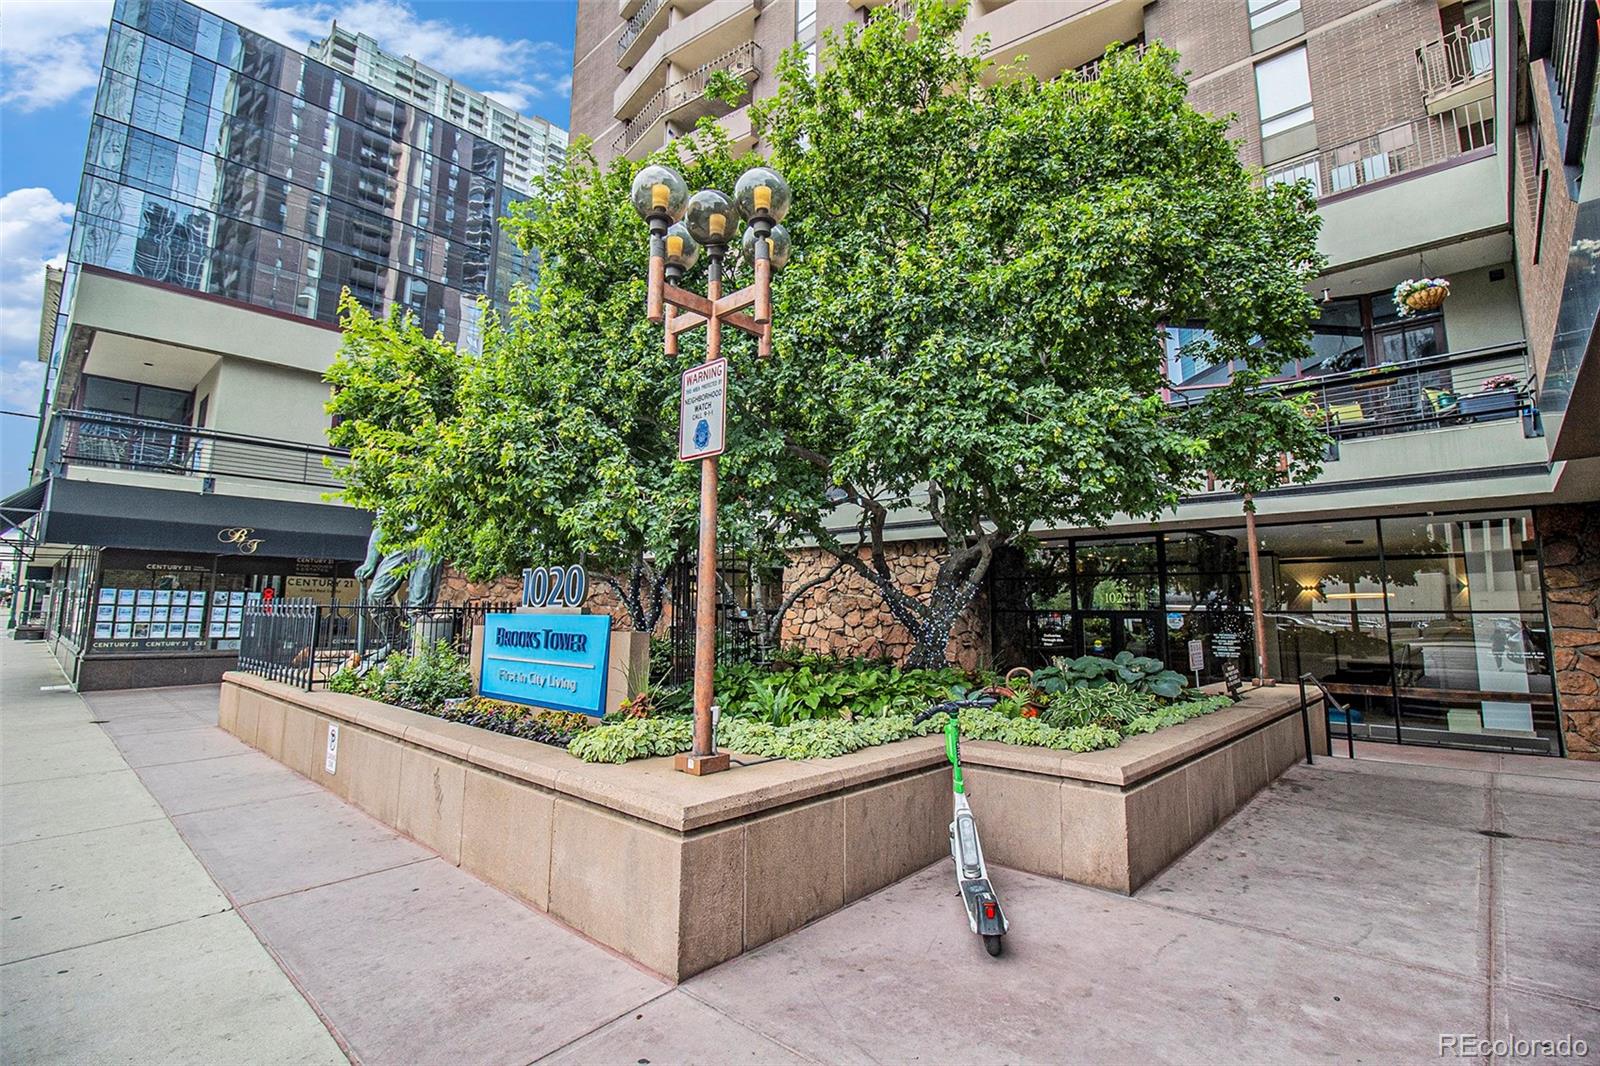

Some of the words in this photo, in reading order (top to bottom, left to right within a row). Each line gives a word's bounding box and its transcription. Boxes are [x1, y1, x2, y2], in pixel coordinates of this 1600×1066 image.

[686, 365, 722, 386] WARNING
[685, 389, 722, 405] NEIGHBORHOOD
[694, 401, 712, 412] WATCH
[692, 413, 703, 421] CALL
[146, 563, 182, 571] CENTURY
[287, 577, 341, 588] CENTURY
[344, 580, 354, 589] 21
[522, 564, 586, 608] 1020
[496, 627, 541, 649] BROOKS
[542, 629, 588, 653] TOWER
[499, 669, 518, 682] First
[519, 673, 528, 685] in
[529, 673, 547, 688] City
[549, 675, 577, 693] Living
